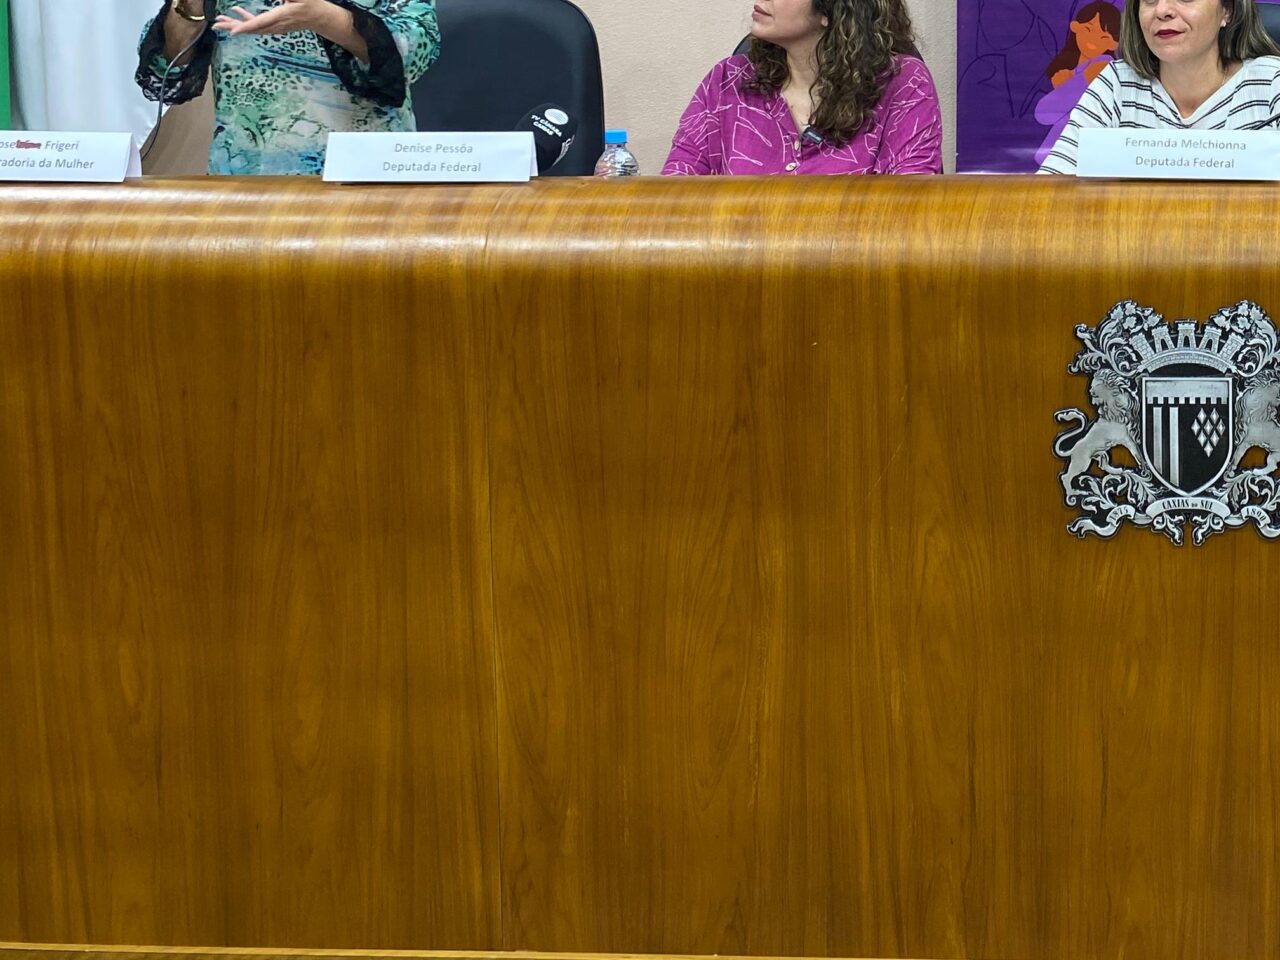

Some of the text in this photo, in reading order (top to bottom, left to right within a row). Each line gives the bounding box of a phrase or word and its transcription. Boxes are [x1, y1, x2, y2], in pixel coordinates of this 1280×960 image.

[45, 140, 80, 152] Frigeri
[394, 143, 433, 153] Denise
[1125, 137, 1247, 150] Fernanda Melchionna
[38, 157, 52, 168] da
[54, 158, 95, 169] Mulher
[383, 161, 481, 173] Deputada Federal
[1135, 155, 1235, 168] Deputada Federal
